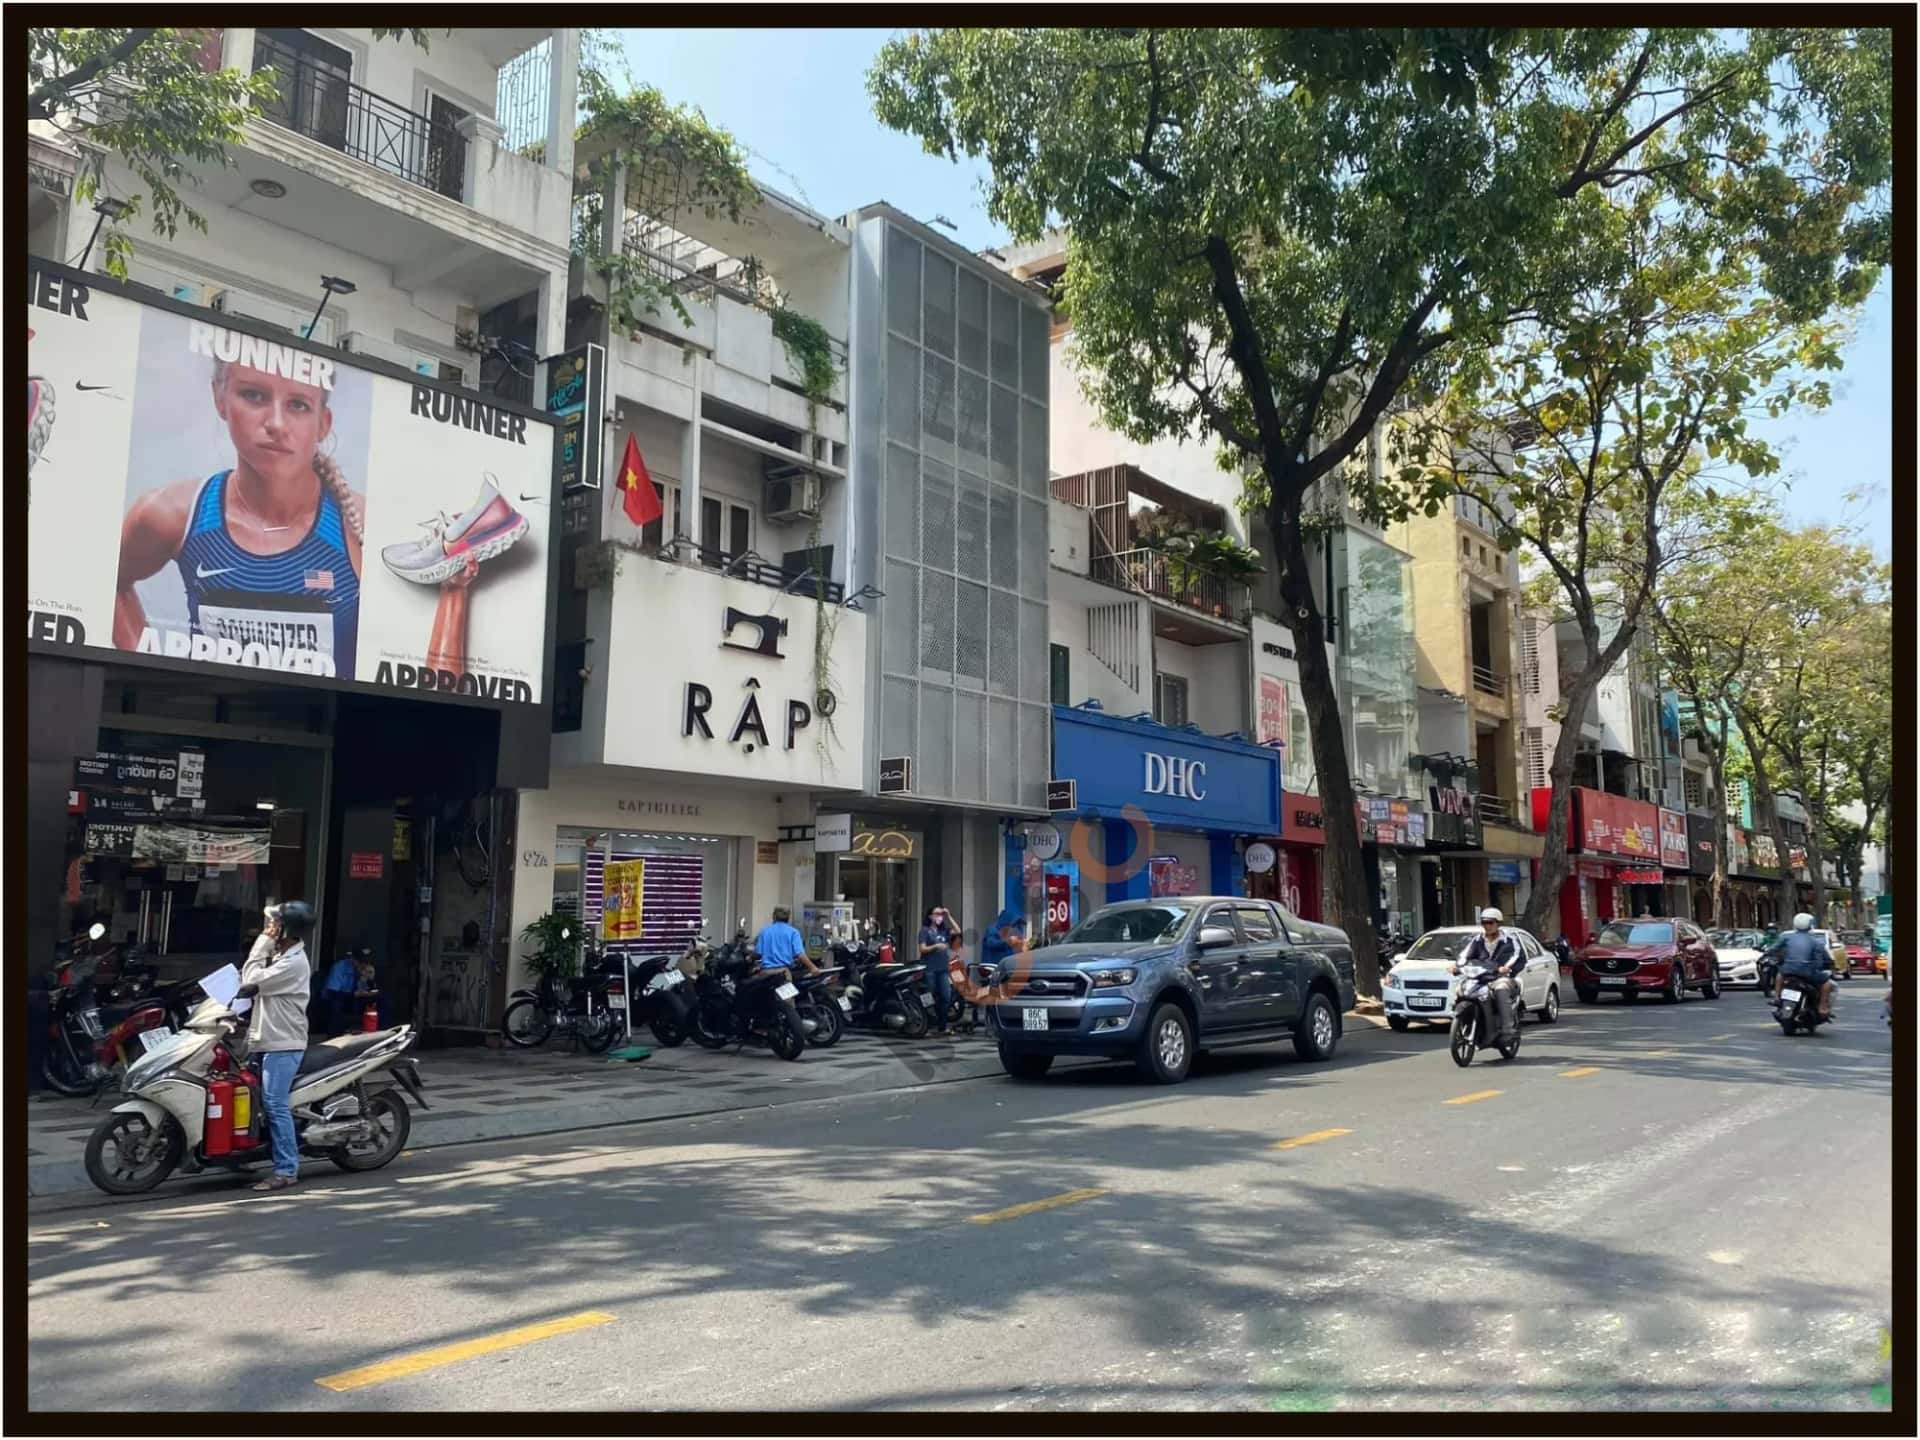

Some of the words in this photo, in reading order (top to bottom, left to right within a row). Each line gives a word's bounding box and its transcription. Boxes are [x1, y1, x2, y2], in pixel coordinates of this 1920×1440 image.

[189, 320, 335, 392] RUNNER
[410, 384, 528, 445] RUNNER
[375, 660, 533, 704] APPROVED
[1143, 751, 1207, 801] DHC
[1033, 835, 1058, 847] DHC
